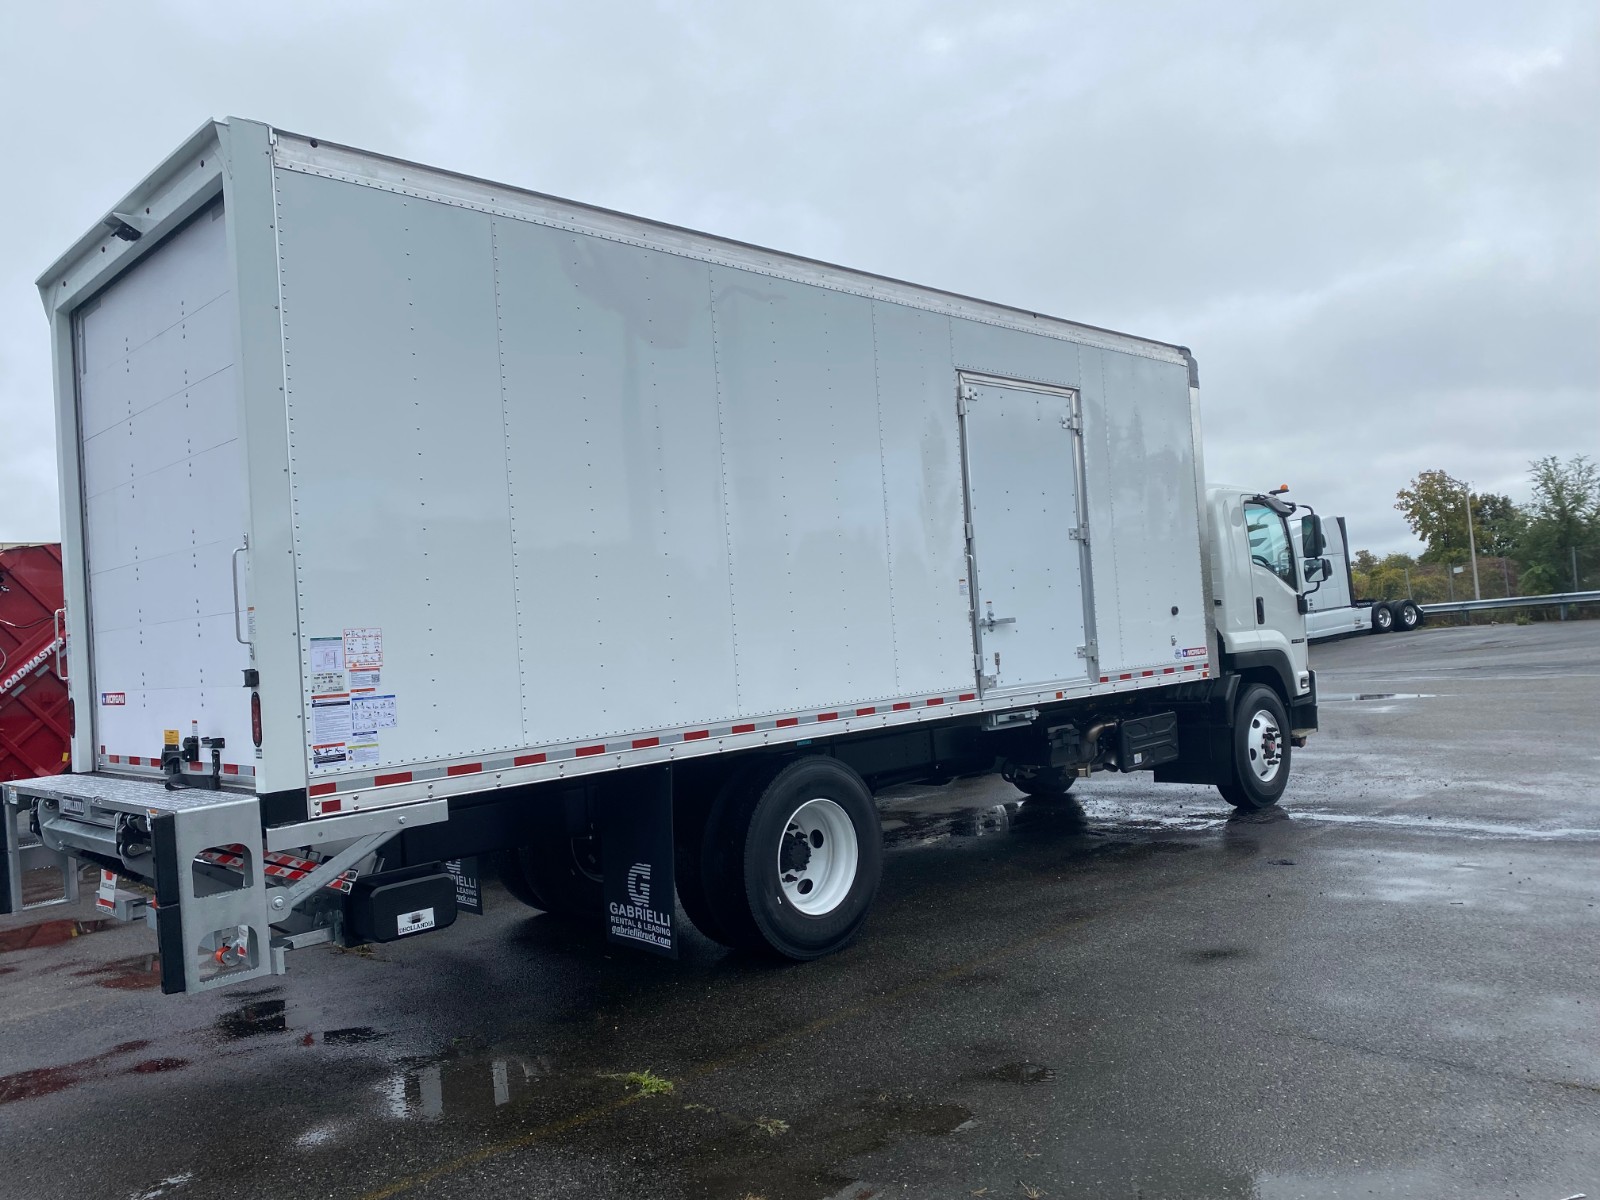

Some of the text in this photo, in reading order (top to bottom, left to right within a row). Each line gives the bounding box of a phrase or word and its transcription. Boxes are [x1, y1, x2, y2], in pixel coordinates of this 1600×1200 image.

[455, 874, 477, 889] IELLI
[609, 902, 671, 927] GABRIELLI
[610, 915, 671, 937] RENTAL & LEASING
[611, 925, 671, 946] gabriellitruck.com
